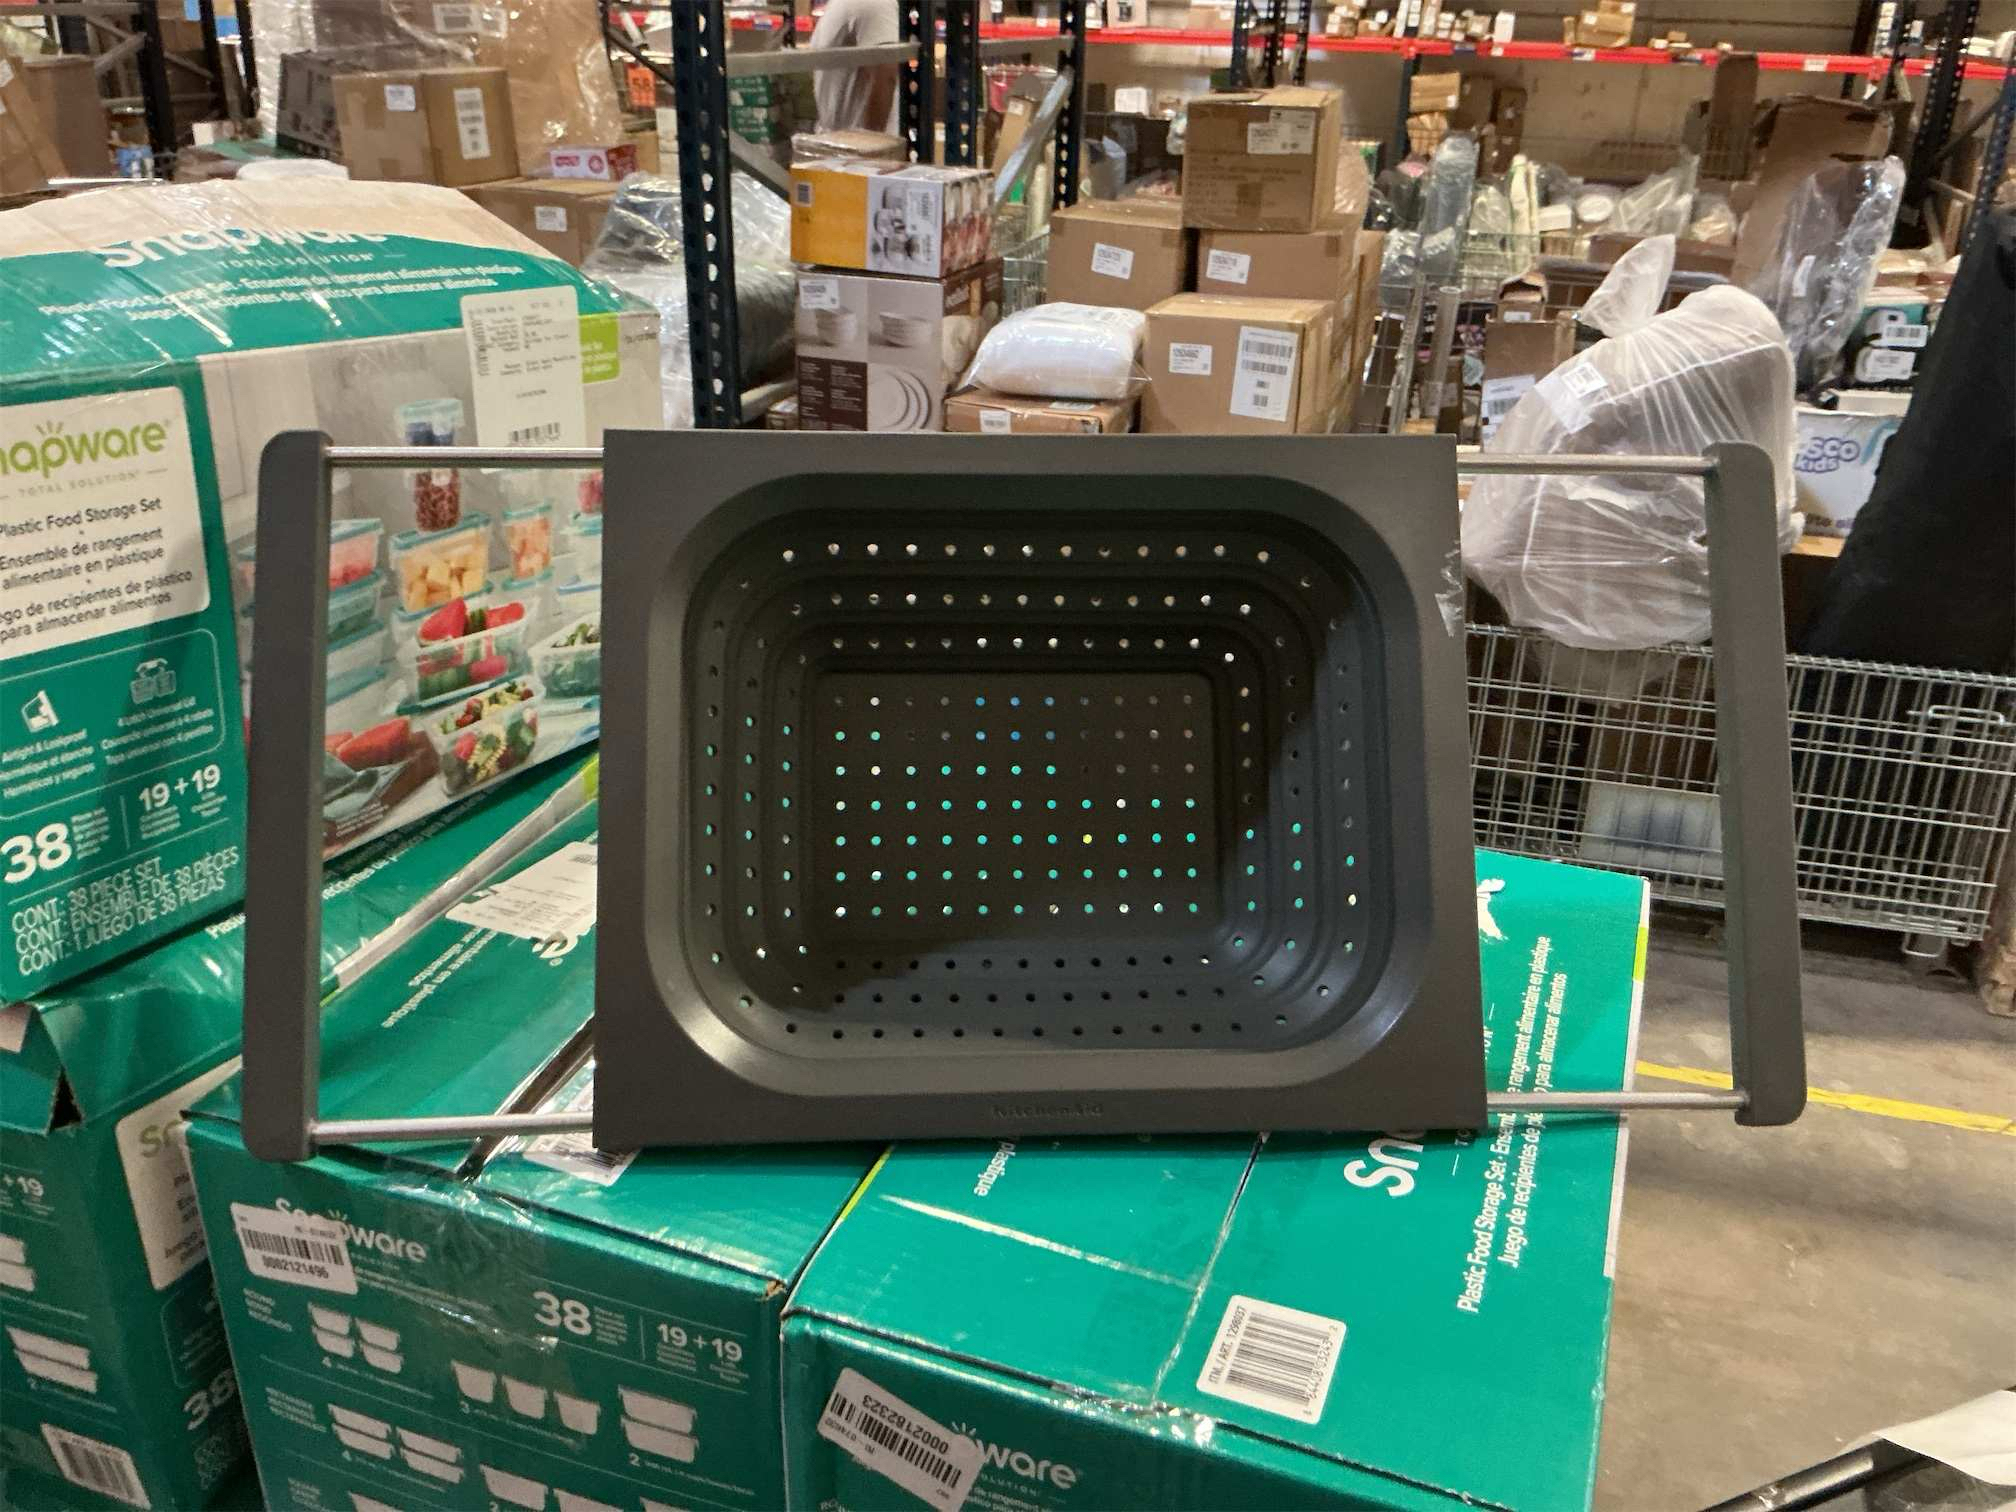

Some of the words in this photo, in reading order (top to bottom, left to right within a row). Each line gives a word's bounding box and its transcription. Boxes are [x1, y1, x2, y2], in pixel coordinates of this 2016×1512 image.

[18, 483, 64, 498] TOTAL
[69, 471, 138, 489] SOLUTION
[46, 511, 82, 530] Food
[85, 502, 137, 523] Storage
[140, 497, 163, 514] Set
[0, 545, 68, 570] Ensemble
[71, 541, 89, 557] de
[92, 527, 163, 552] rangement
[2, 564, 81, 591] alimentaire
[85, 558, 103, 573] en
[105, 546, 165, 571] plastique
[0, 623, 32, 646] para
[36, 604, 106, 633] almacenar
[109, 591, 173, 616] alimentos
[26, 601, 44, 617] de
[47, 582, 122, 610] recipientes
[124, 577, 142, 594] de
[138, 781, 171, 812] 19
[191, 763, 222, 794] 19
[0, 822, 73, 885] 38
[67, 886, 89, 911] 38
[90, 868, 132, 901] PIECE
[134, 856, 162, 881] SET
[71, 883, 150, 932] ENSEMBLE
[151, 874, 171, 898] DE
[174, 865, 192, 889] 38
[84, 911, 135, 950] JUEGO
[137, 900, 159, 925] DE
[159, 892, 177, 916] 38
[179, 871, 226, 906] PIEZAS
[1528, 936, 1555, 974] plastique
[1529, 972, 1544, 986] en
[1544, 971, 1568, 1015] alimentos
[1515, 985, 1542, 1034] alimentaire
[1509, 1033, 1532, 1087] rangement
[1536, 1013, 1561, 1064] almacenar
[1534, 1062, 1553, 1089] para
[1519, 1124, 1541, 1144] de
[973, 1140, 1017, 1198] plastique
[1484, 1156, 1508, 1184] Set
[1509, 1142, 1539, 1208] recipientes
[1474, 1183, 1507, 1231] Storage
[1505, 1207, 1529, 1226] de
[1467, 1228, 1494, 1265] Food
[1497, 1223, 1530, 1269] Juego
[1456, 1262, 1487, 1313] Plastic
[533, 1290, 593, 1336] 38
[657, 1323, 688, 1348] 19
[711, 1338, 743, 1363] 19
[861, 1394, 950, 1455] 0002182323
[628, 1452, 641, 1468] 2
